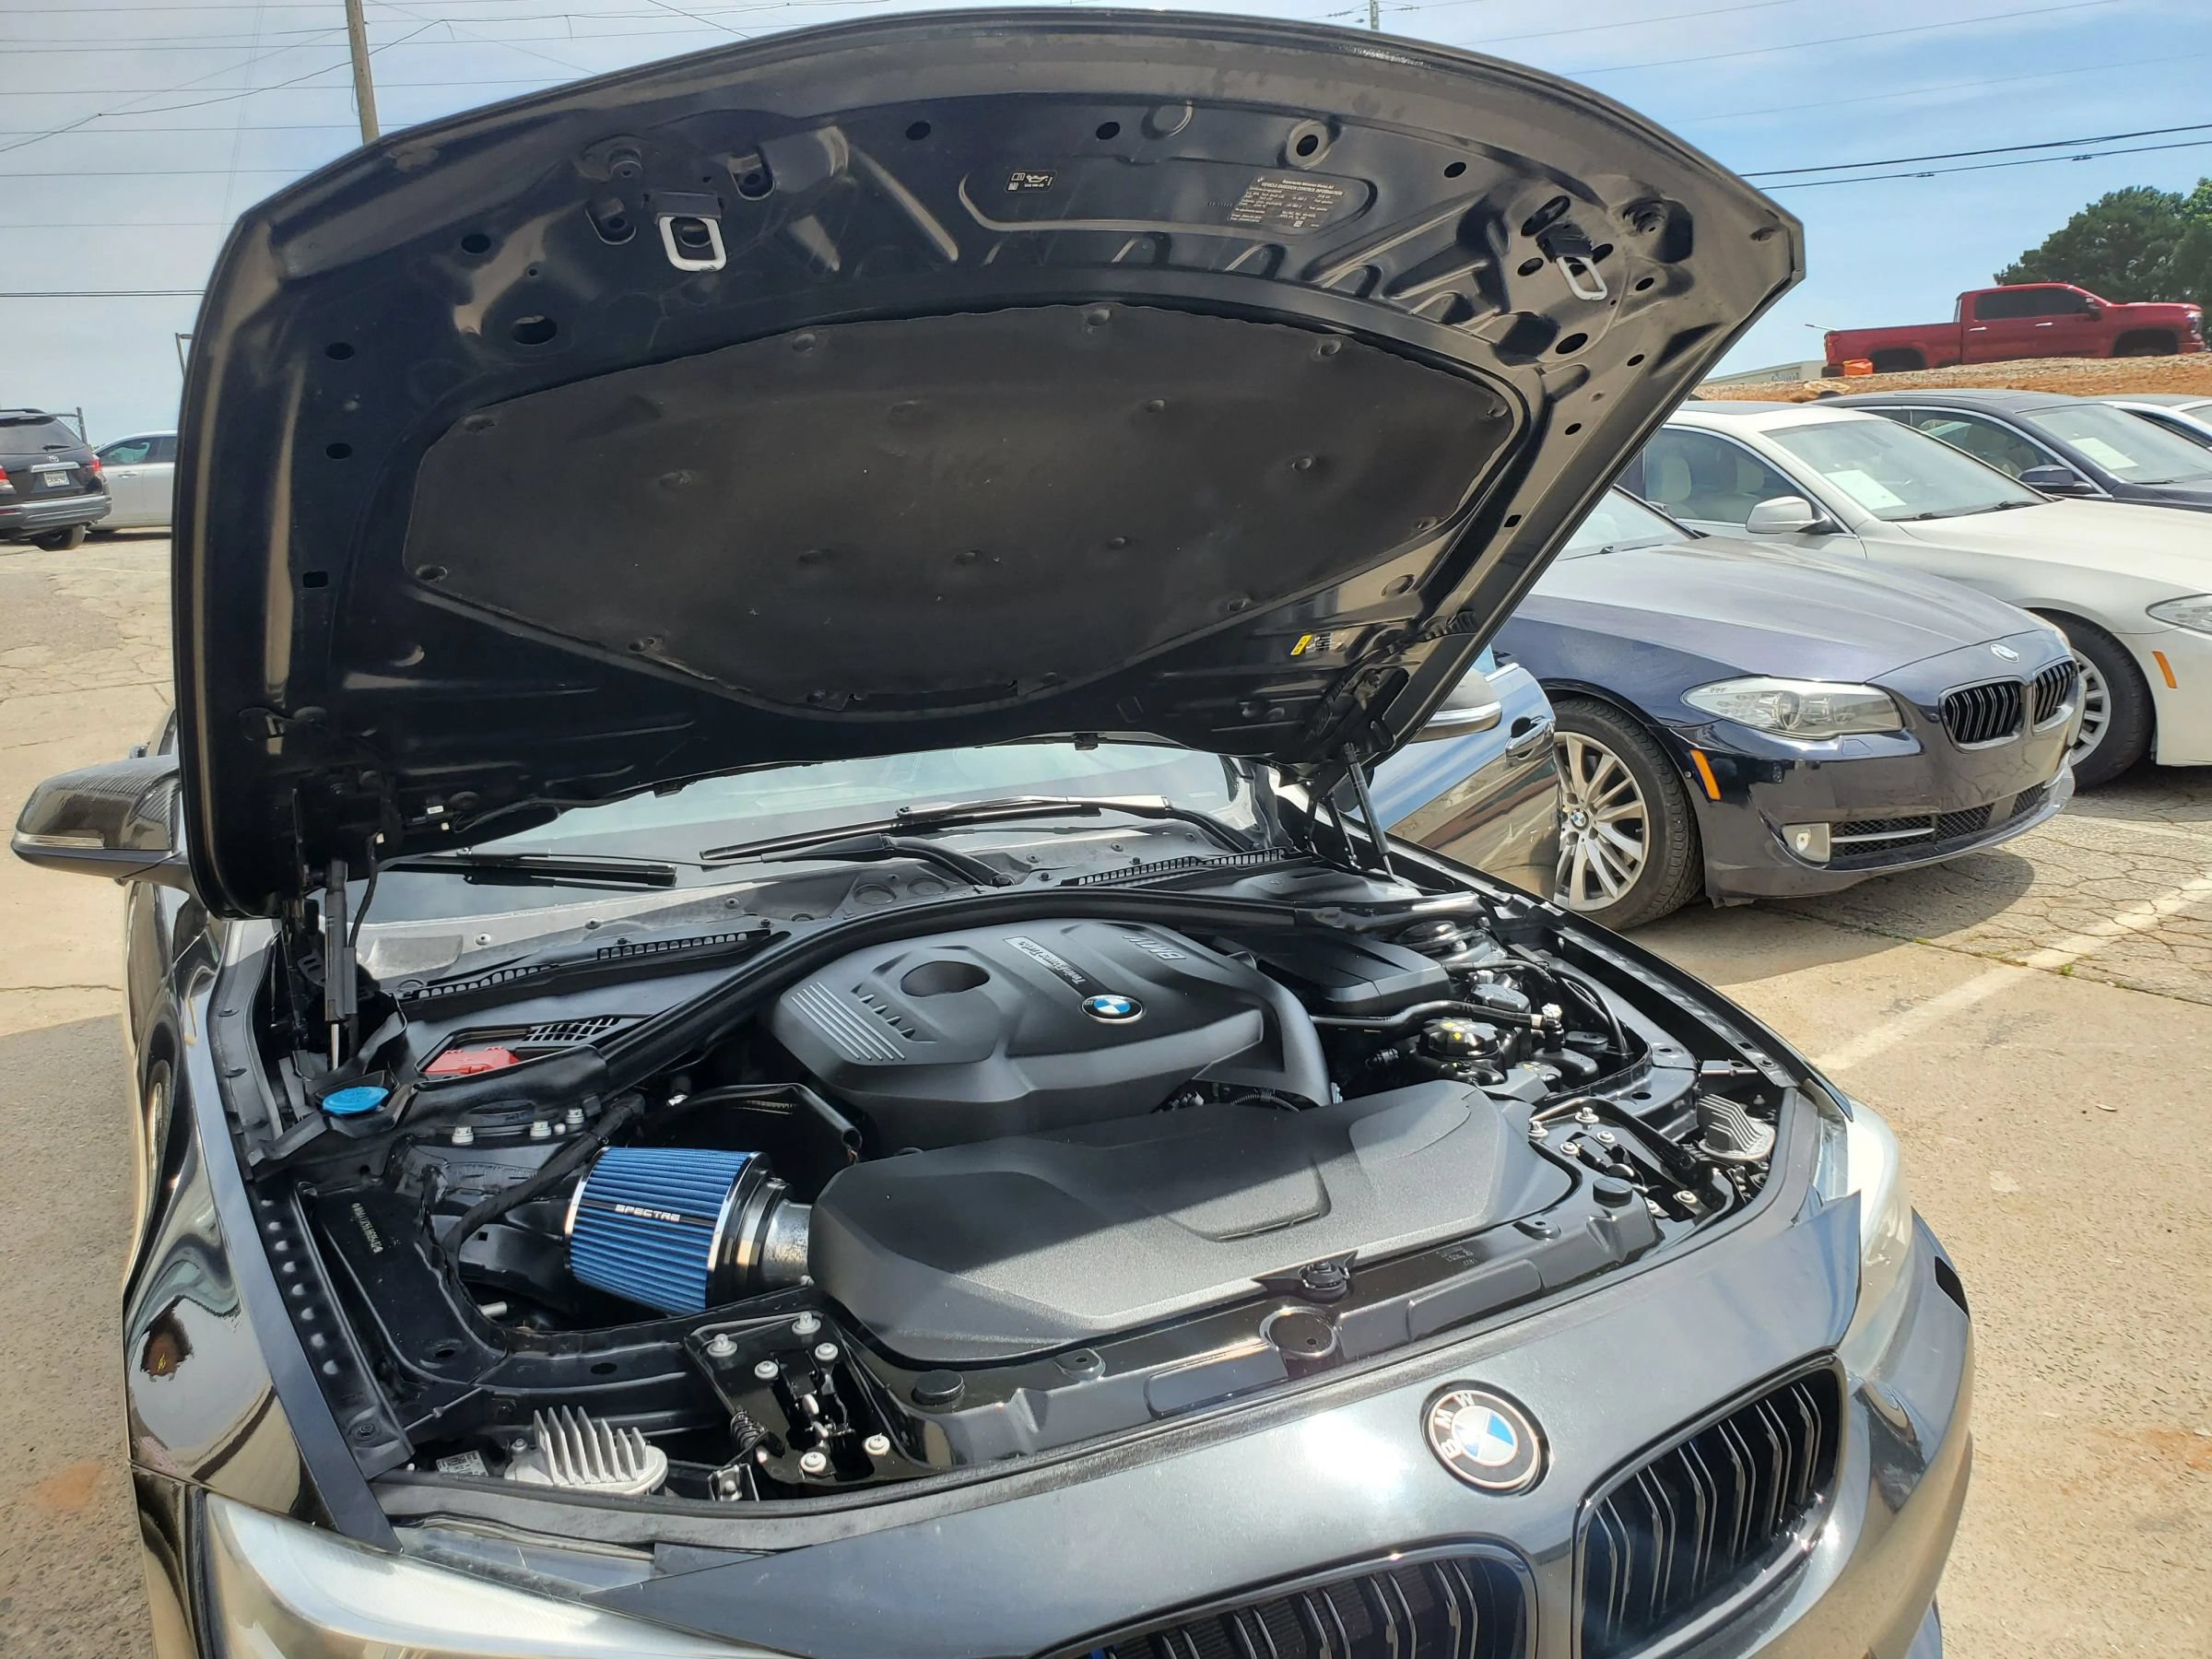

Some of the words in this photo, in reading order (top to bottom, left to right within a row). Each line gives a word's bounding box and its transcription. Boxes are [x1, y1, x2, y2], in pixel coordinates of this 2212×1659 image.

[1122, 935, 1187, 959] BMW
[615, 1204, 681, 1222] SPECTRE
[1434, 1393, 1476, 1461] BMW
